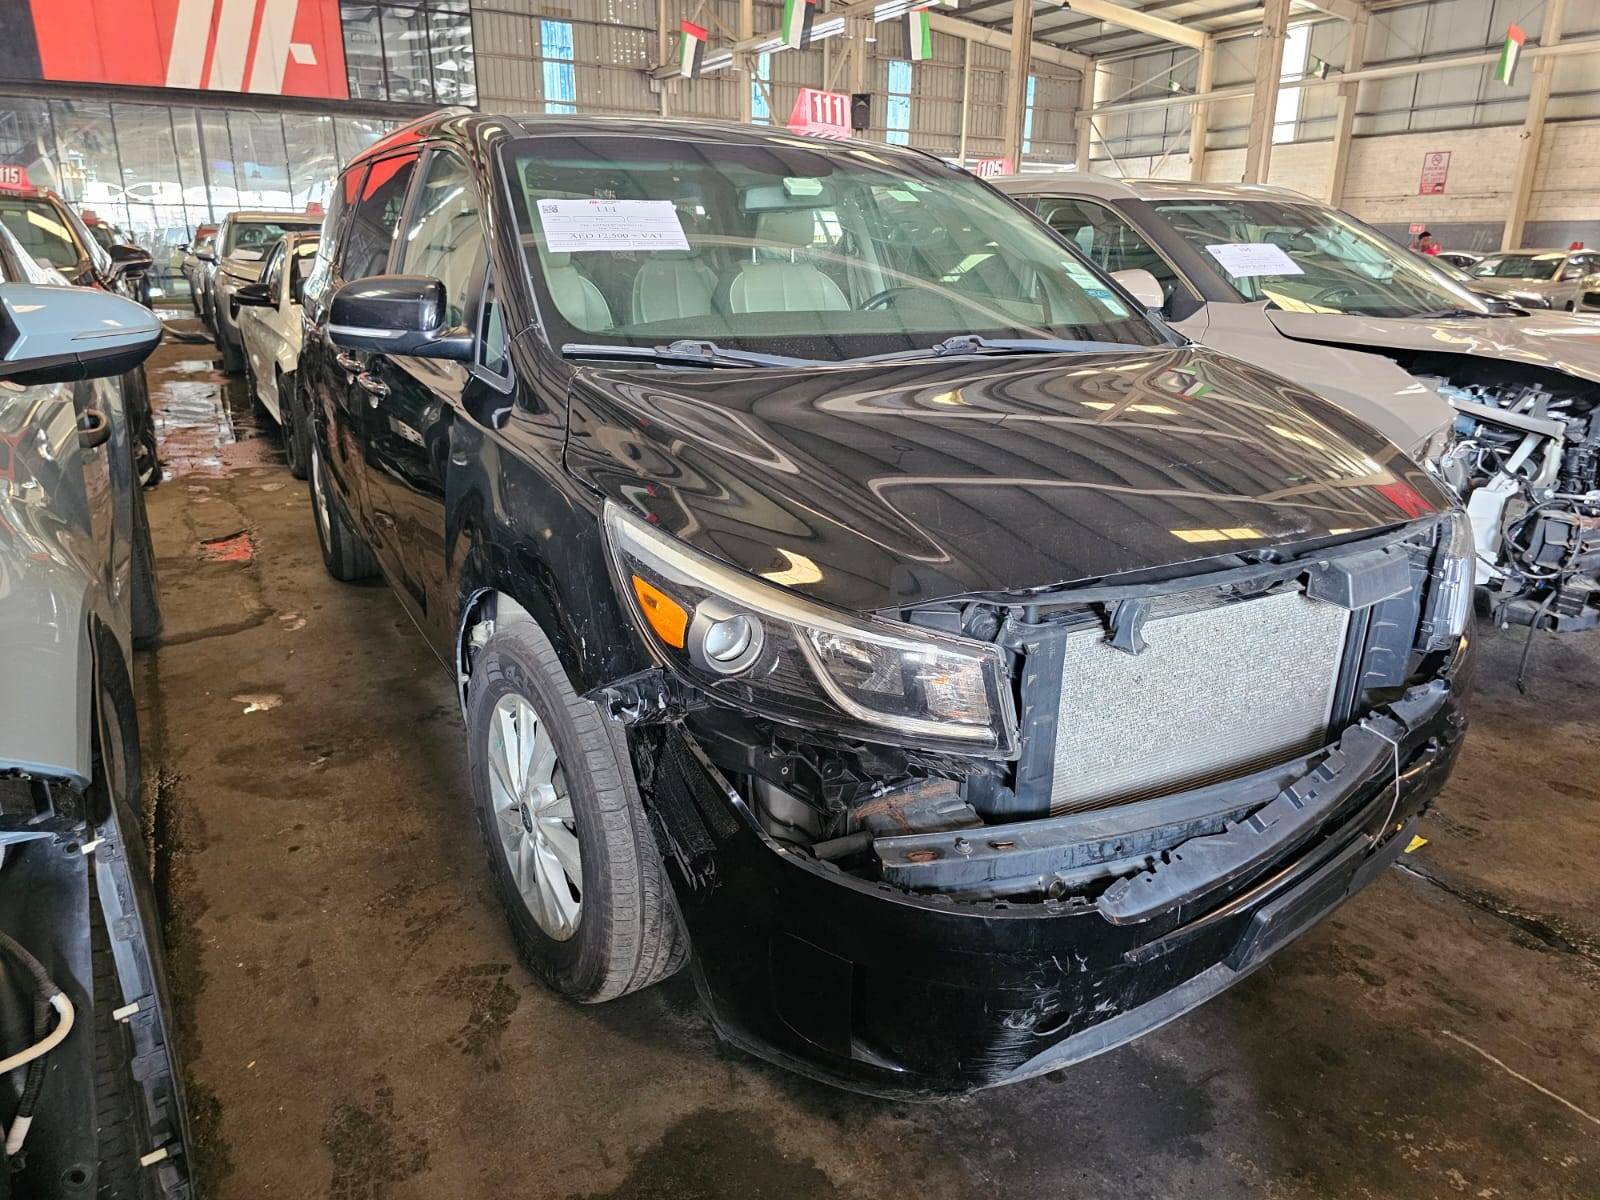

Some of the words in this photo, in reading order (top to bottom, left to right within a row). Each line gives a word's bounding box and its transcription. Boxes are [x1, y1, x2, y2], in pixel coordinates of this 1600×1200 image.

[813, 93, 842, 127] 111
[0, 167, 19, 184] 115
[980, 160, 1003, 177] 105
